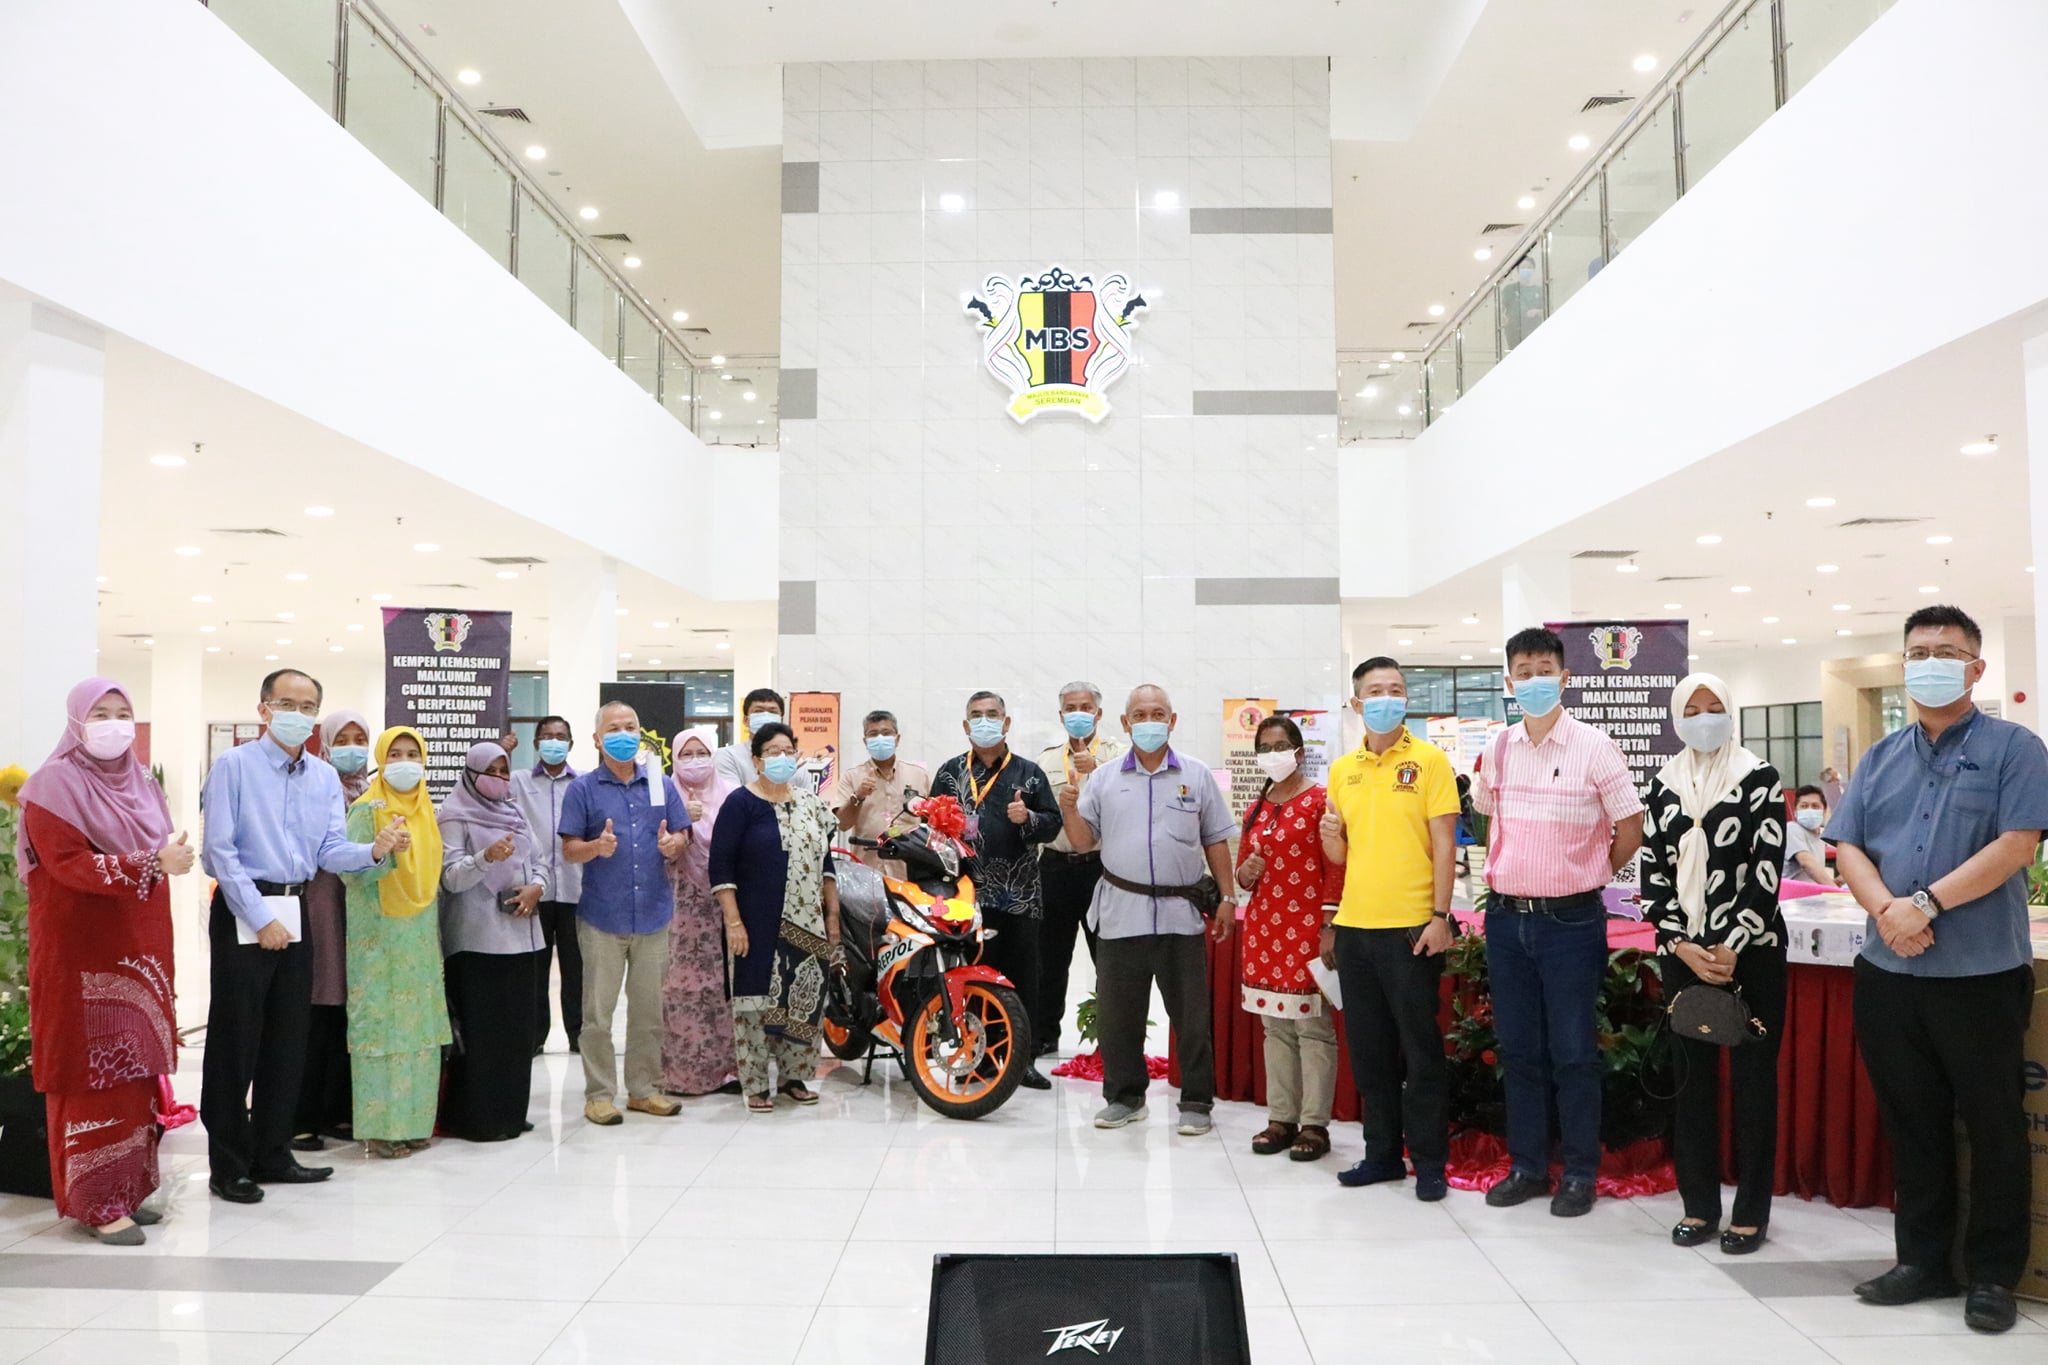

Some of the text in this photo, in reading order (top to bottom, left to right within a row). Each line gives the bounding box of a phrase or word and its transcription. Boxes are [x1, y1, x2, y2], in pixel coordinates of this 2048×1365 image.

[1025, 328, 1089, 350] MBS
[1035, 397, 1081, 405] SEREMBAN
[393, 656, 500, 669] KEMPEN KEMASKINI
[417, 670, 478, 682] MAKLUMAT
[1566, 675, 1677, 688] EMPEN KEMASKINI
[402, 684, 492, 697] CUKAI TAKSIRAN
[1582, 691, 1650, 704] MAKLUMAT
[407, 699, 486, 711] & BERPELUANG
[416, 713, 476, 725] MENYERTAI
[1606, 707, 1667, 720] TAKSIRAN
[415, 727, 500, 739] GRAM CABUTAN
[427, 755, 466, 767] EHINGG
[1231, 784, 1251, 792] ANDU
[878, 939, 914, 972] REPSOL
[1042, 1318, 1125, 1356] PEAVEY
